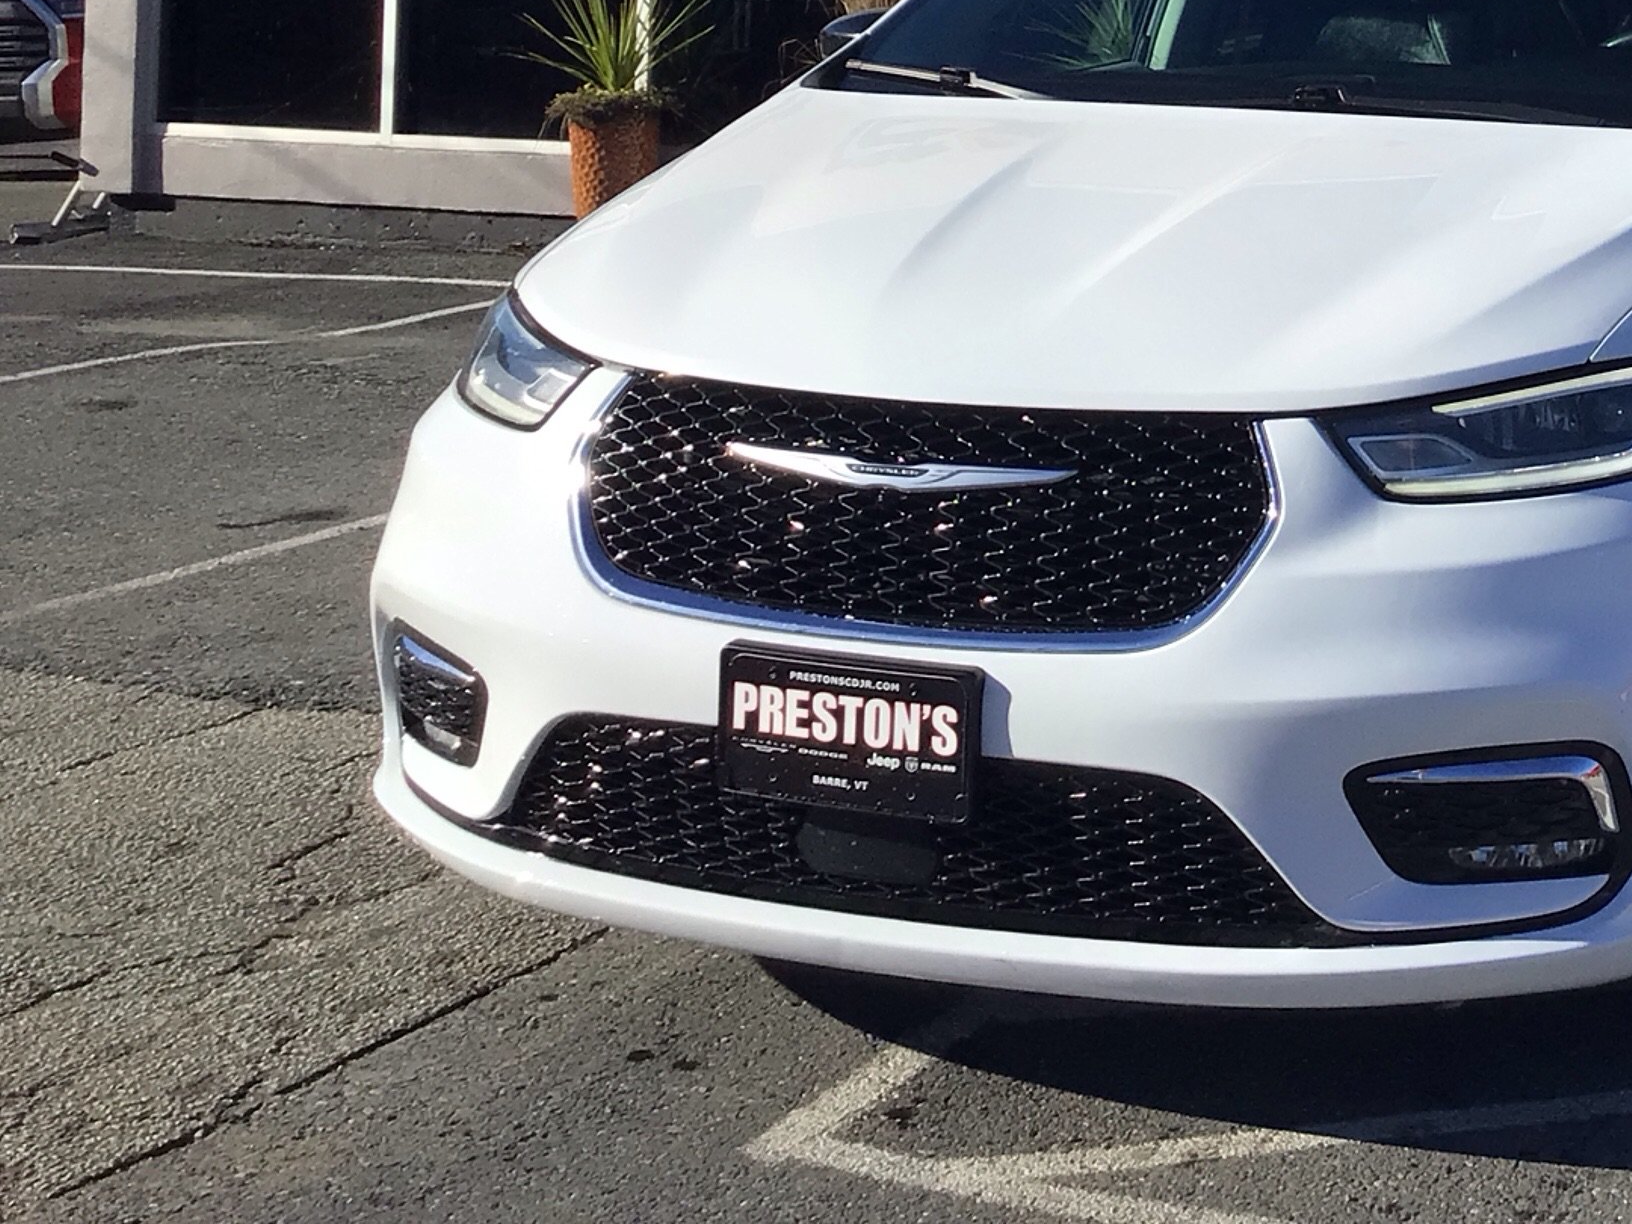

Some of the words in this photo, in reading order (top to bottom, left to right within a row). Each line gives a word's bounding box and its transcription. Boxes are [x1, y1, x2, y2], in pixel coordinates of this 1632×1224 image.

[789, 670, 900, 693] PRESTONSCDJR.COM
[731, 680, 959, 758] PRESTON'S
[798, 747, 849, 760] DODGE
[866, 752, 901, 771] Jeep
[920, 761, 957, 774] RAM
[812, 774, 851, 790] BARRE,
[853, 779, 870, 790] VT
